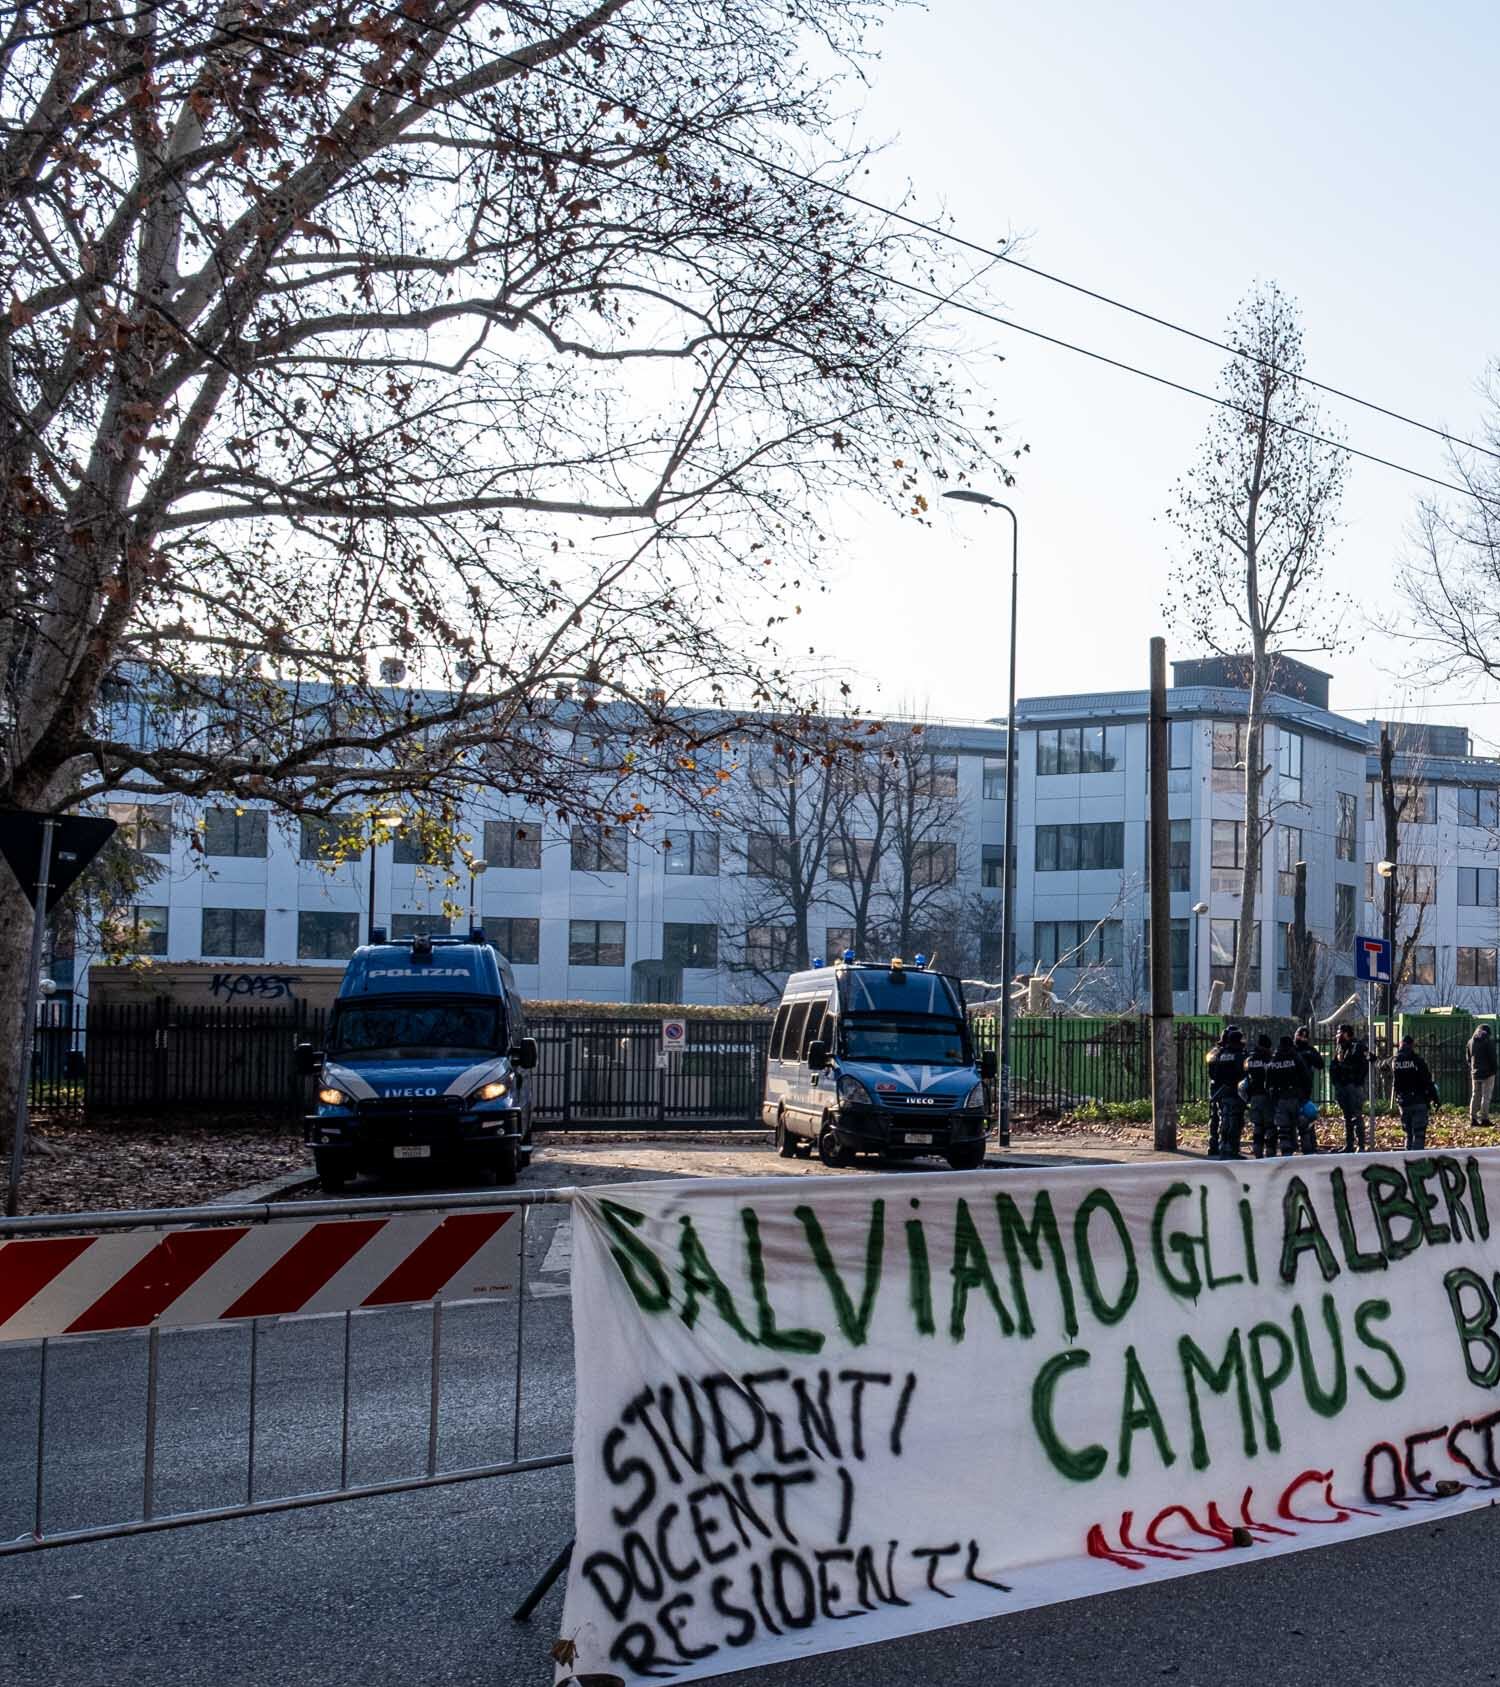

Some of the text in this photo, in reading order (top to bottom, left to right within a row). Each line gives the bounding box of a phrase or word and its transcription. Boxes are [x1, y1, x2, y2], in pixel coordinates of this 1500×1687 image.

[369, 968, 471, 978] POLIZIA
[384, 1087, 437, 1098] IVECO
[906, 1097, 934, 1105] IVECO
[1279, 1156, 1491, 1285] ALBERI
[602, 1369, 917, 1528] STUDENTI
[1031, 1294, 1405, 1483] CAMPUS
[582, 1466, 856, 1622] DOCENTI
[609, 1539, 1013, 1679] RESIDENTI
